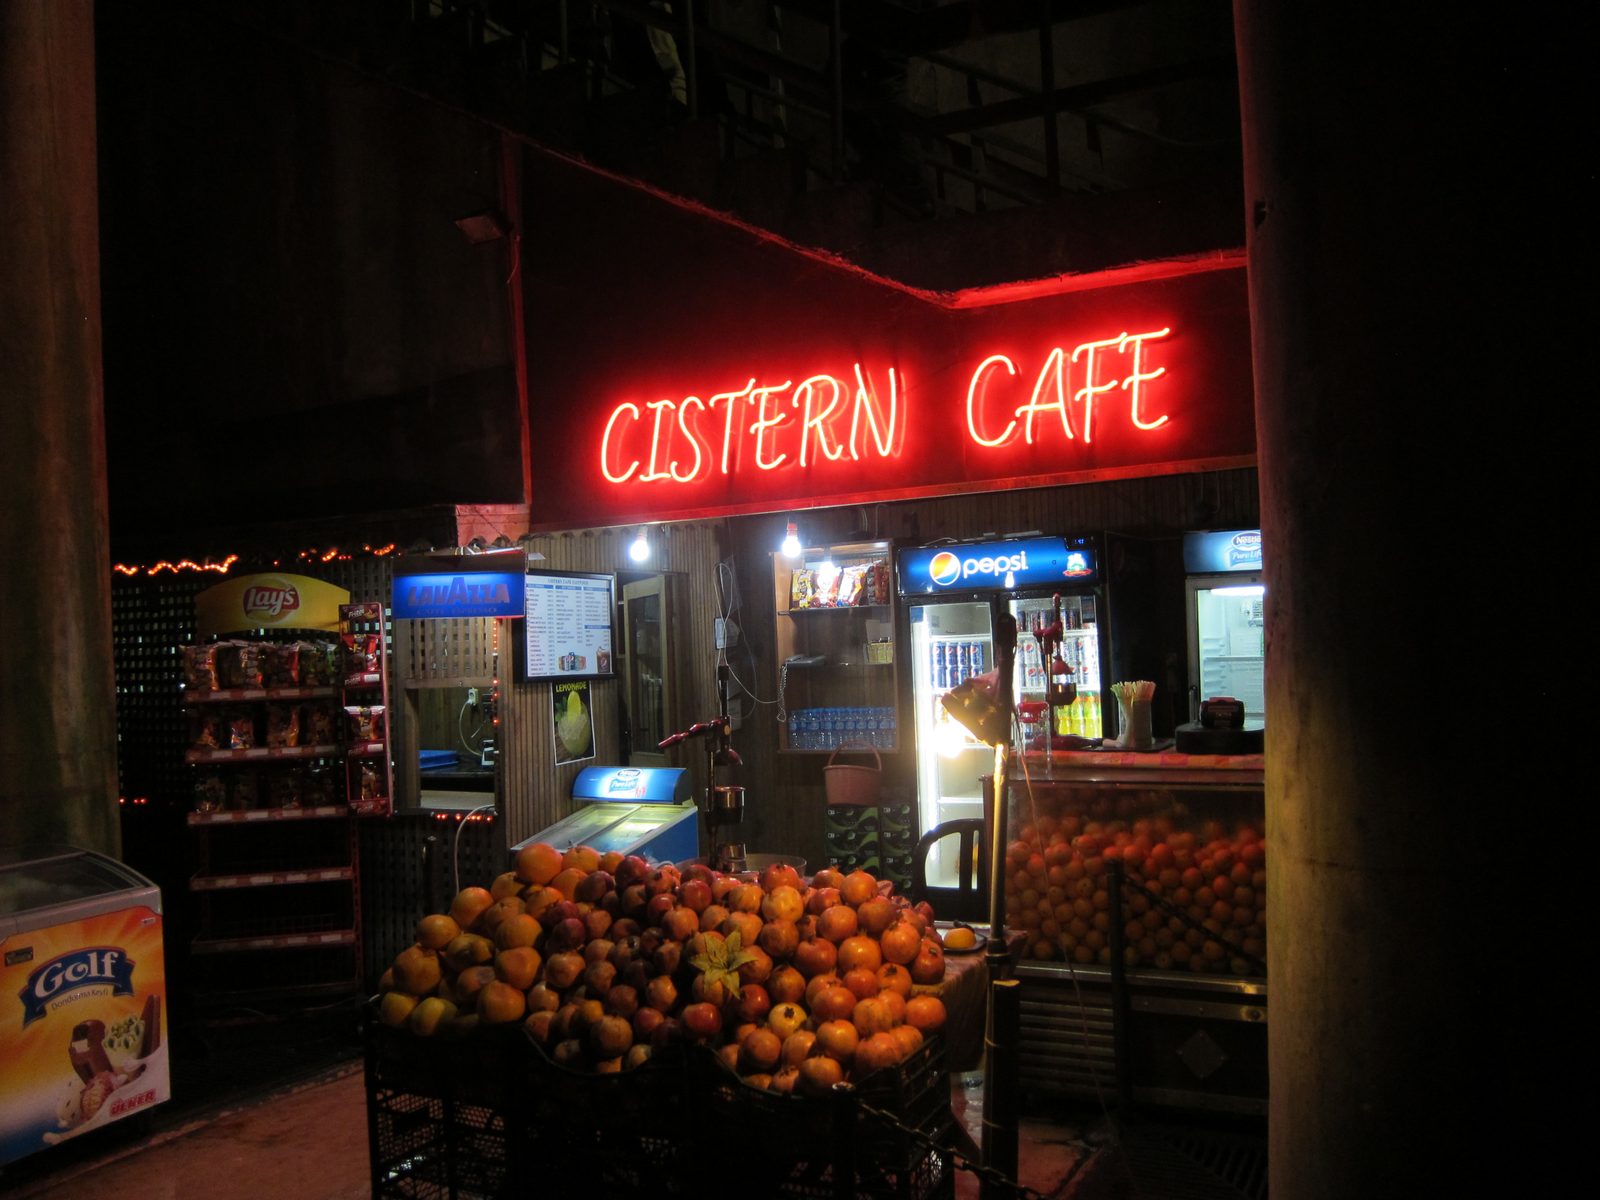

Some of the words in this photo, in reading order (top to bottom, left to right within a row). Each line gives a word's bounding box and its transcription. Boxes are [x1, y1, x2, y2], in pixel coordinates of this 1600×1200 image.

[600, 363, 897, 484] CISTERN
[966, 327, 1171, 448] CAFE
[963, 550, 1028, 579] pepsi
[407, 576, 511, 607] LAVAZZA
[555, 681, 588, 693] LEMONADE
[34, 950, 120, 999] Golf
